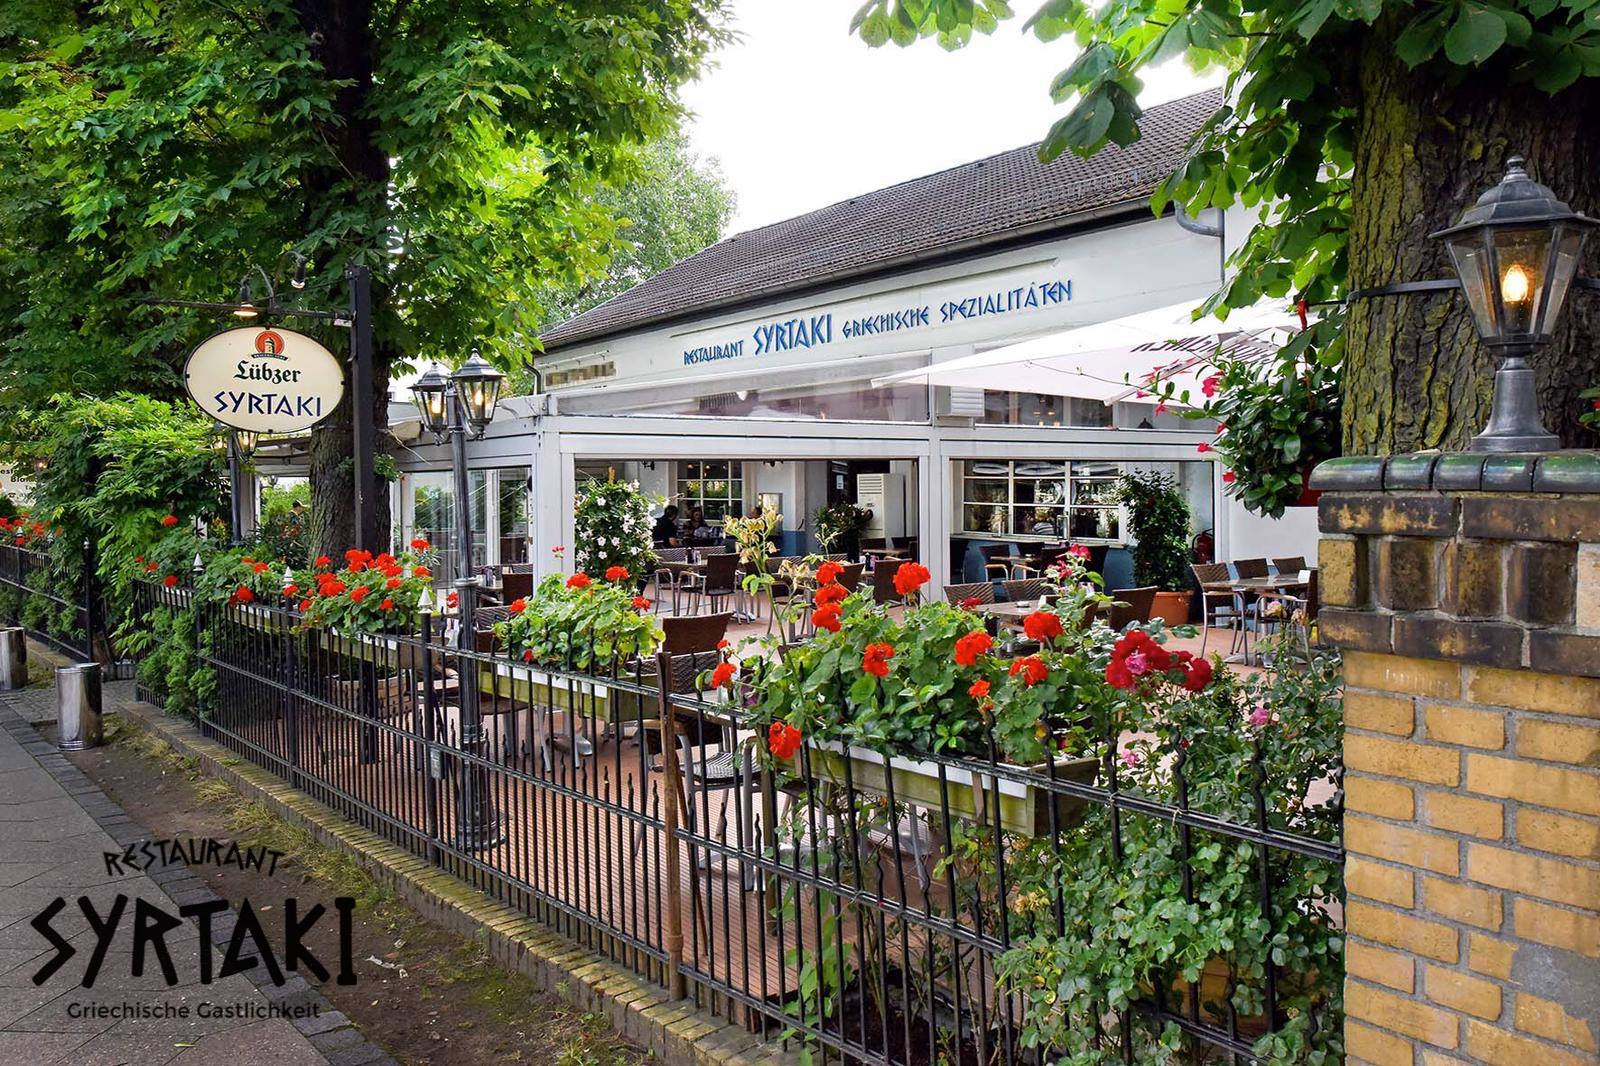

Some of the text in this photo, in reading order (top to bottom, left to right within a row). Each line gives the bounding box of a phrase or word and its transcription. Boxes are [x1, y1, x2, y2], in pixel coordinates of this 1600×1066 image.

[684, 339, 744, 366] RESTAURANT
[752, 313, 833, 355] SYRTAKI
[842, 306, 930, 338] GRIECHISCHE
[233, 360, 302, 385] Lübzer
[214, 391, 321, 417] SYRTAKI
